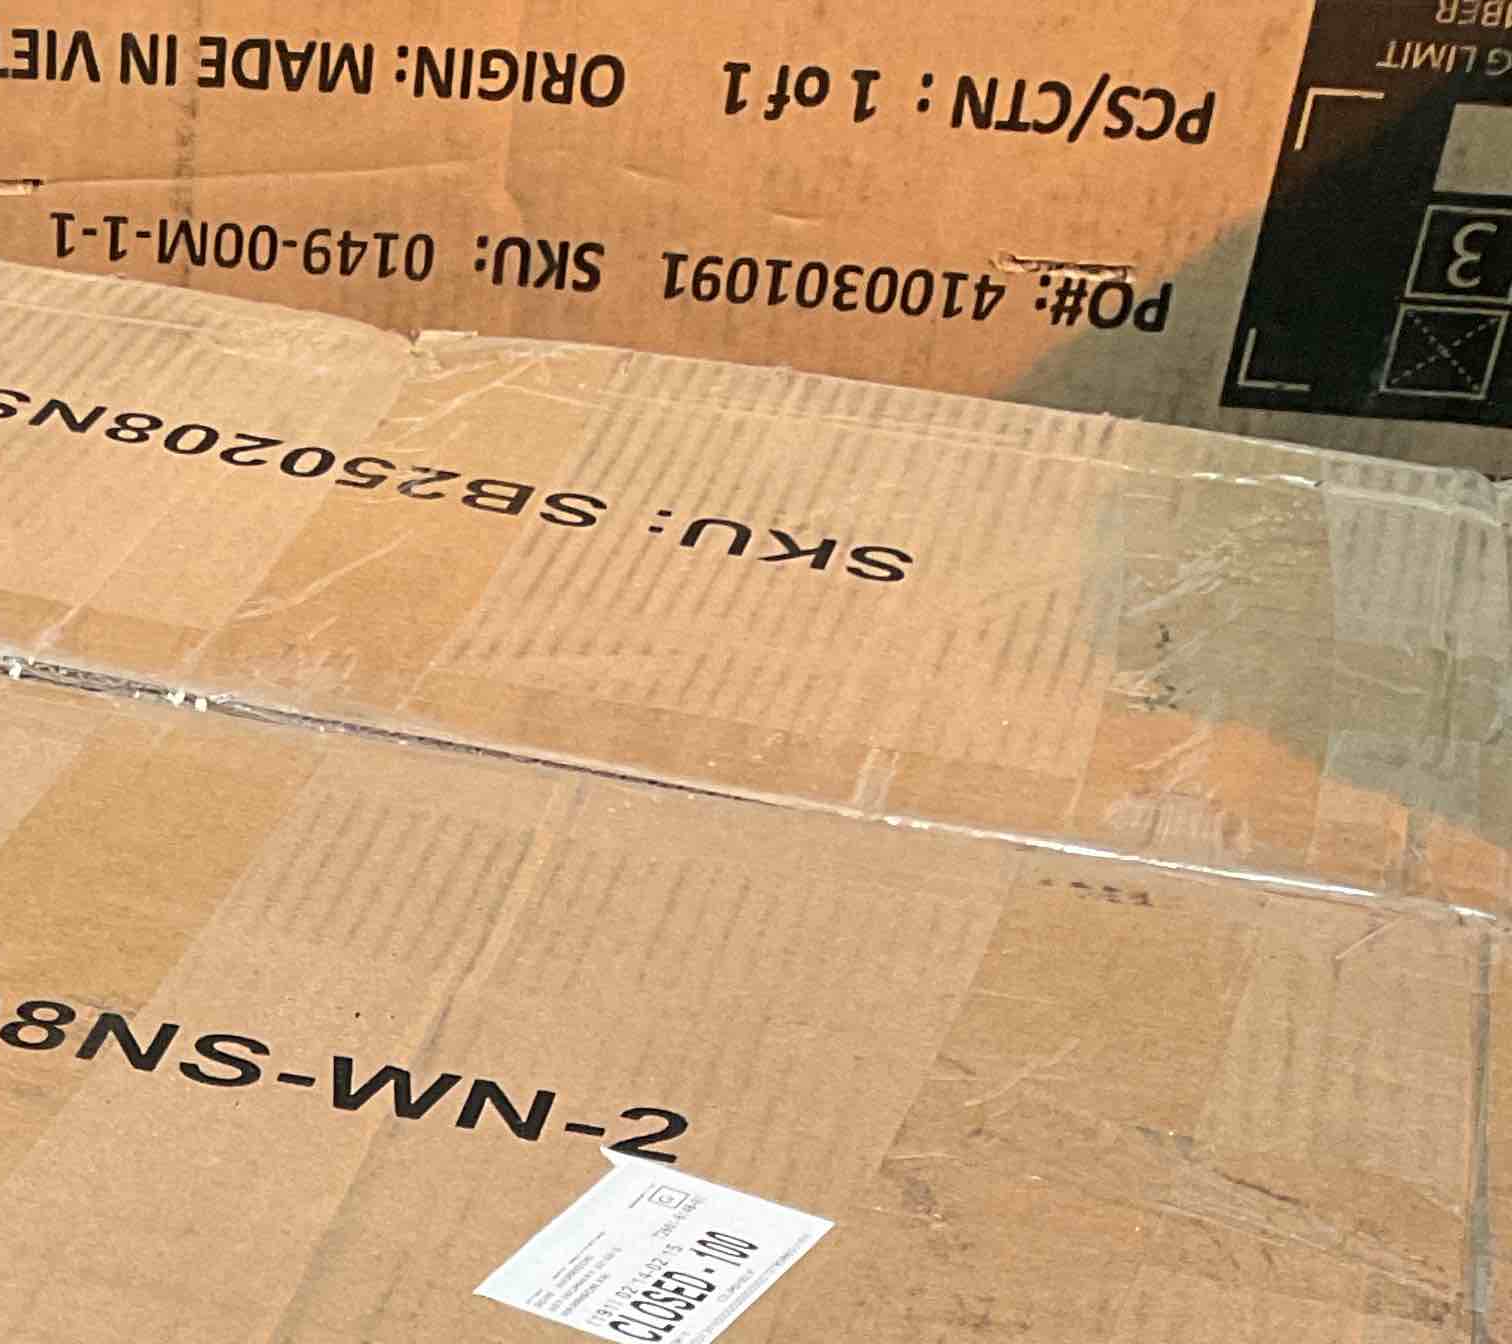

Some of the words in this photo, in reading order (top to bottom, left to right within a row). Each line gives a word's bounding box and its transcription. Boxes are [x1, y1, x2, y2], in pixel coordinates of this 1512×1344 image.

[119, 31, 178, 87] IN
[196, 34, 375, 96] MADE
[395, 44, 626, 109] ORIGIN:
[1376, 39, 1478, 74] LIMIT
[723, 60, 751, 116] 1
[765, 64, 831, 122] of
[852, 68, 882, 124] 1
[950, 72, 1217, 146] PCS/CTN
[49, 210, 436, 283] 0149-00M-1-1
[474, 234, 607, 293] SKU:
[1448, 221, 1496, 286] 3
[661, 250, 1006, 323] 4100301091
[1033, 273, 1174, 333] PO#:
[647, 508, 914, 584] SKU:
[608, 1269, 716, 1343] CLOSED
[688, 1230, 760, 1267] 100
